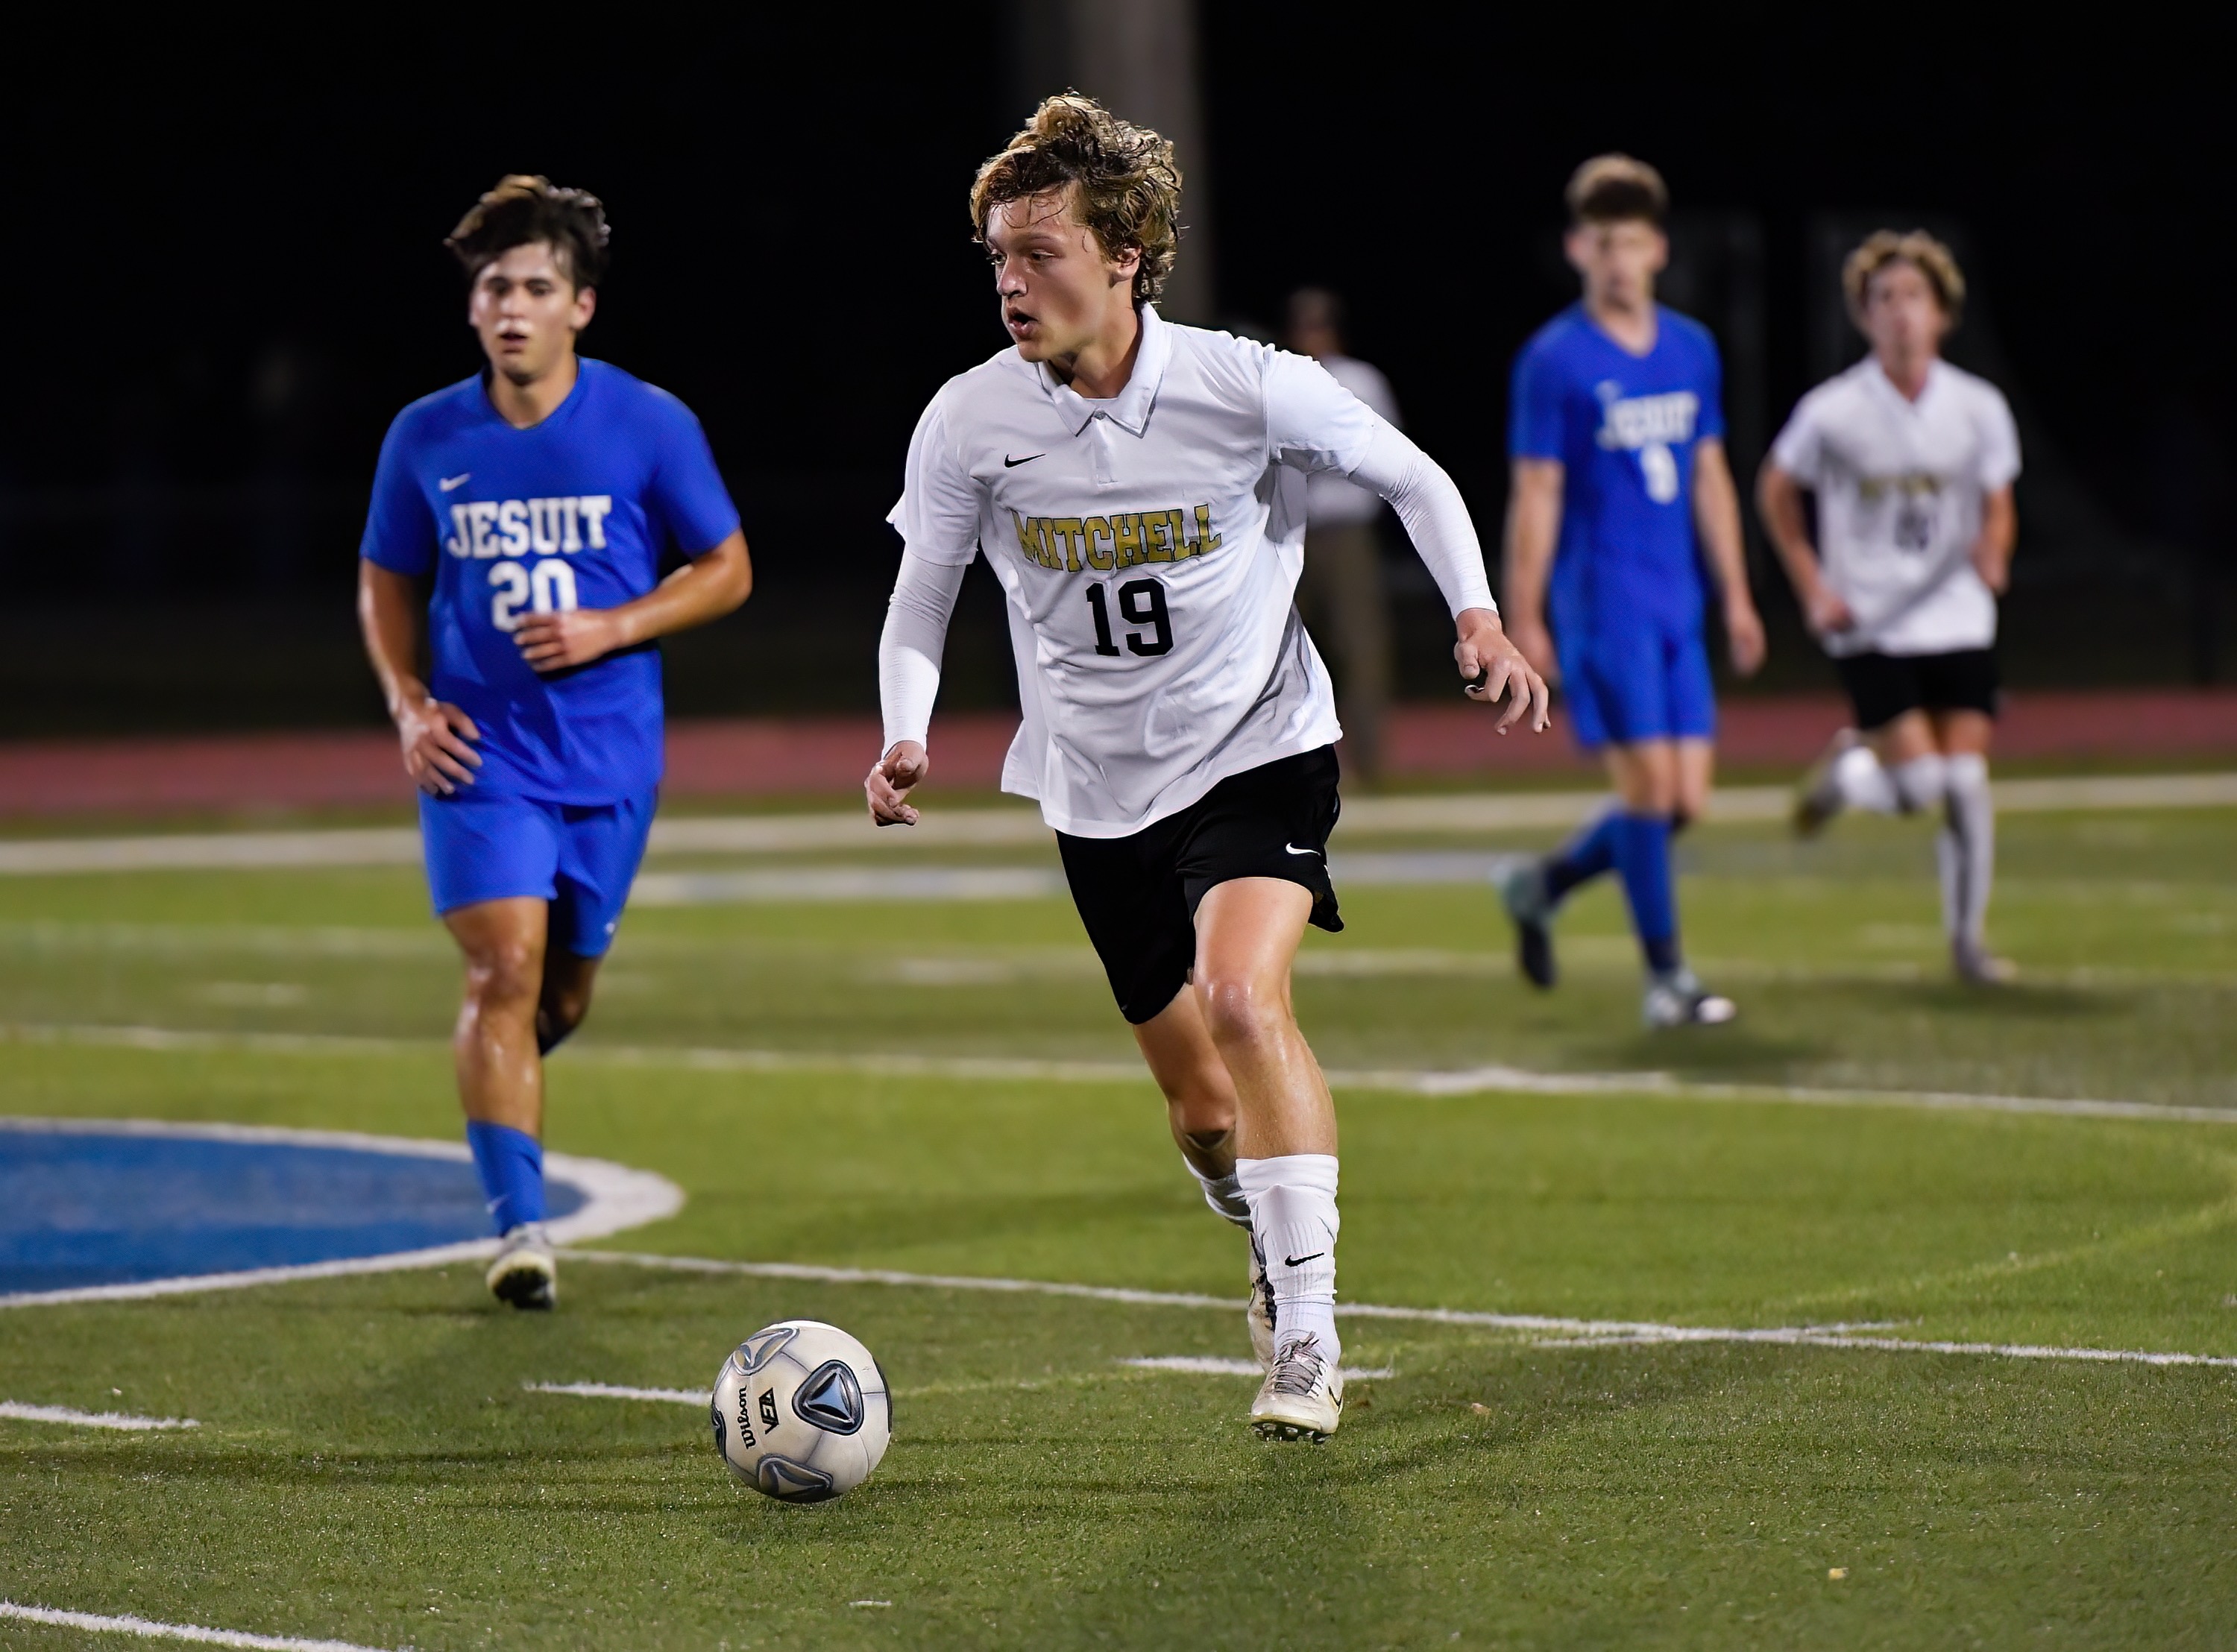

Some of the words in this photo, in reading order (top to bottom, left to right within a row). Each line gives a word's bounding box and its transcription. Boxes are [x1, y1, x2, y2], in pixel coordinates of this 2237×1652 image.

[448, 495, 612, 558] JESUIT
[1013, 504, 1222, 573] MITCHELL
[488, 558, 578, 633] 20
[1086, 578, 1174, 658] 19
[737, 1385, 756, 1449] Wilson
